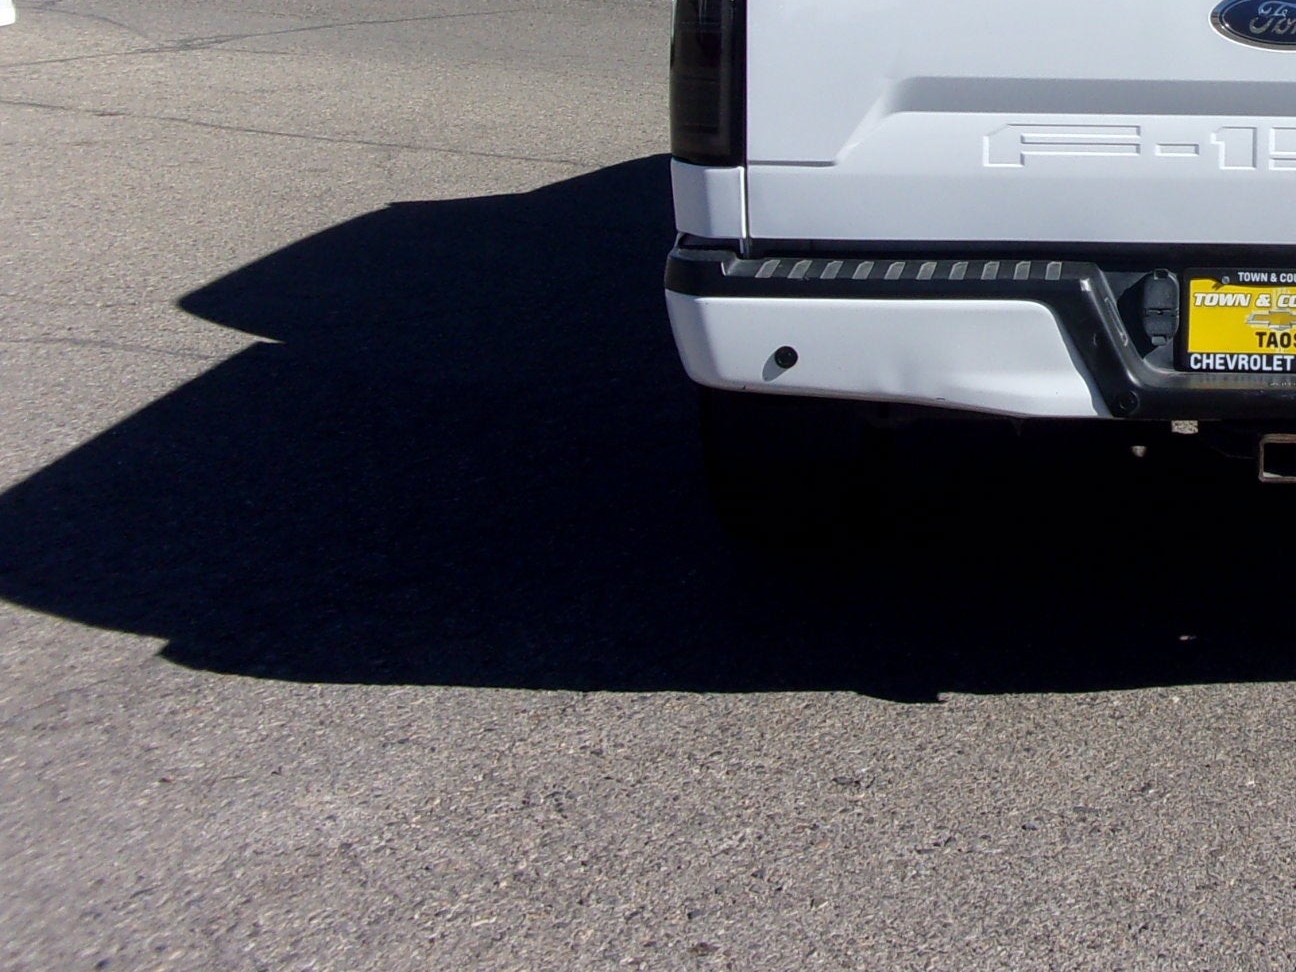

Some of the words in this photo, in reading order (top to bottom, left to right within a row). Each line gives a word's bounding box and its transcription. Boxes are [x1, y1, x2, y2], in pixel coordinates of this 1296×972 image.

[1238, 272, 1269, 282] TOWN
[1270, 272, 1278, 283] &
[1193, 292, 1251, 307] TOWN
[1255, 293, 1271, 308] &
[1190, 353, 1295, 371] CHEVROLET
